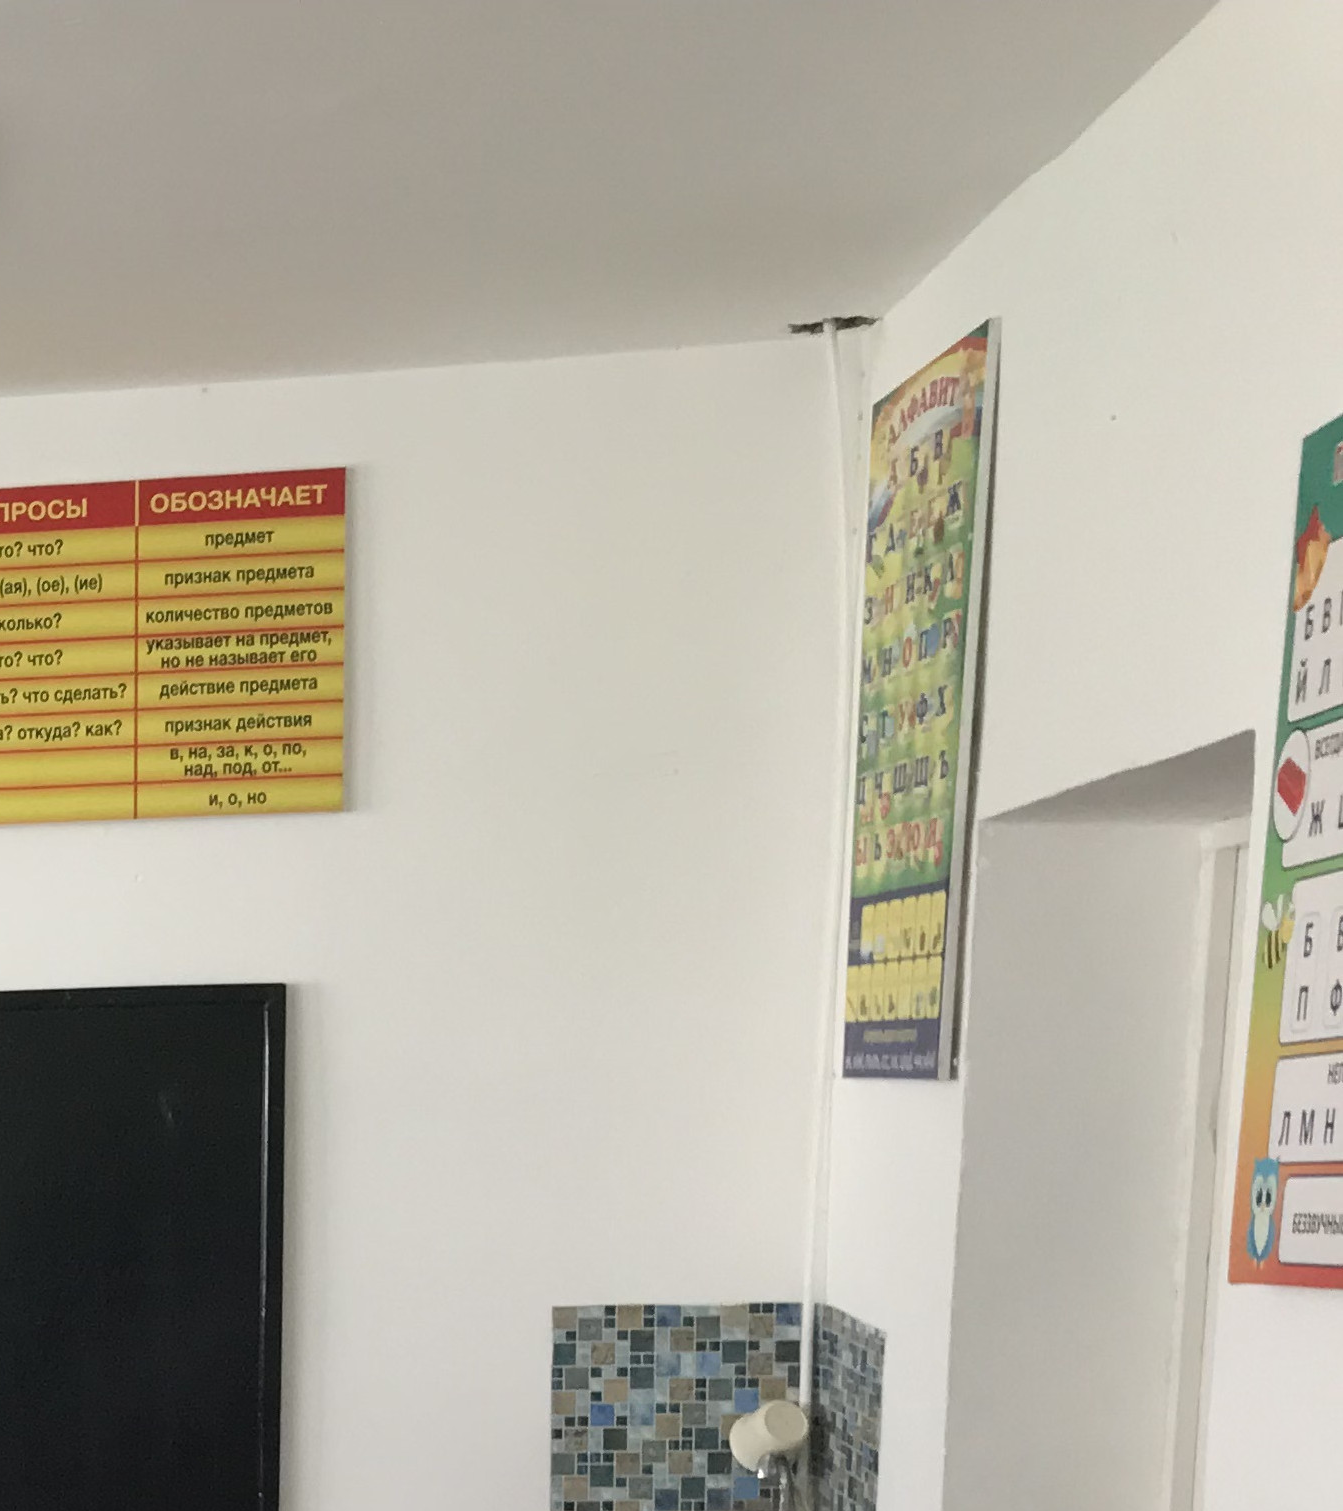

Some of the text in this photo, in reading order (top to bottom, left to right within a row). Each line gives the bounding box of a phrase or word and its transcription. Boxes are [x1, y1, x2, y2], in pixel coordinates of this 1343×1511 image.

[150, 484, 328, 514] ОБОЗНАЧАЕТ
[27, 538, 64, 556] что?
[205, 530, 274, 549] предмет
[74, 574, 103, 593] (ие)
[164, 565, 314, 589] признак предмета
[146, 602, 333, 623] количество предметов
[146, 629, 332, 654] указывает на предмет,
[27, 649, 63, 666] что?
[161, 650, 317, 668] но не называет его
[22, 690, 50, 703] что
[54, 682, 127, 704] сделать?
[159, 677, 318, 699] действие предмета
[17, 721, 81, 743] откуда?
[85, 719, 122, 736] как?
[165, 714, 312, 736] признак действия
[189, 747, 212, 760] на,
[217, 745, 239, 760] за,
[283, 743, 306, 757] по,
[247, 792, 267, 805] но
